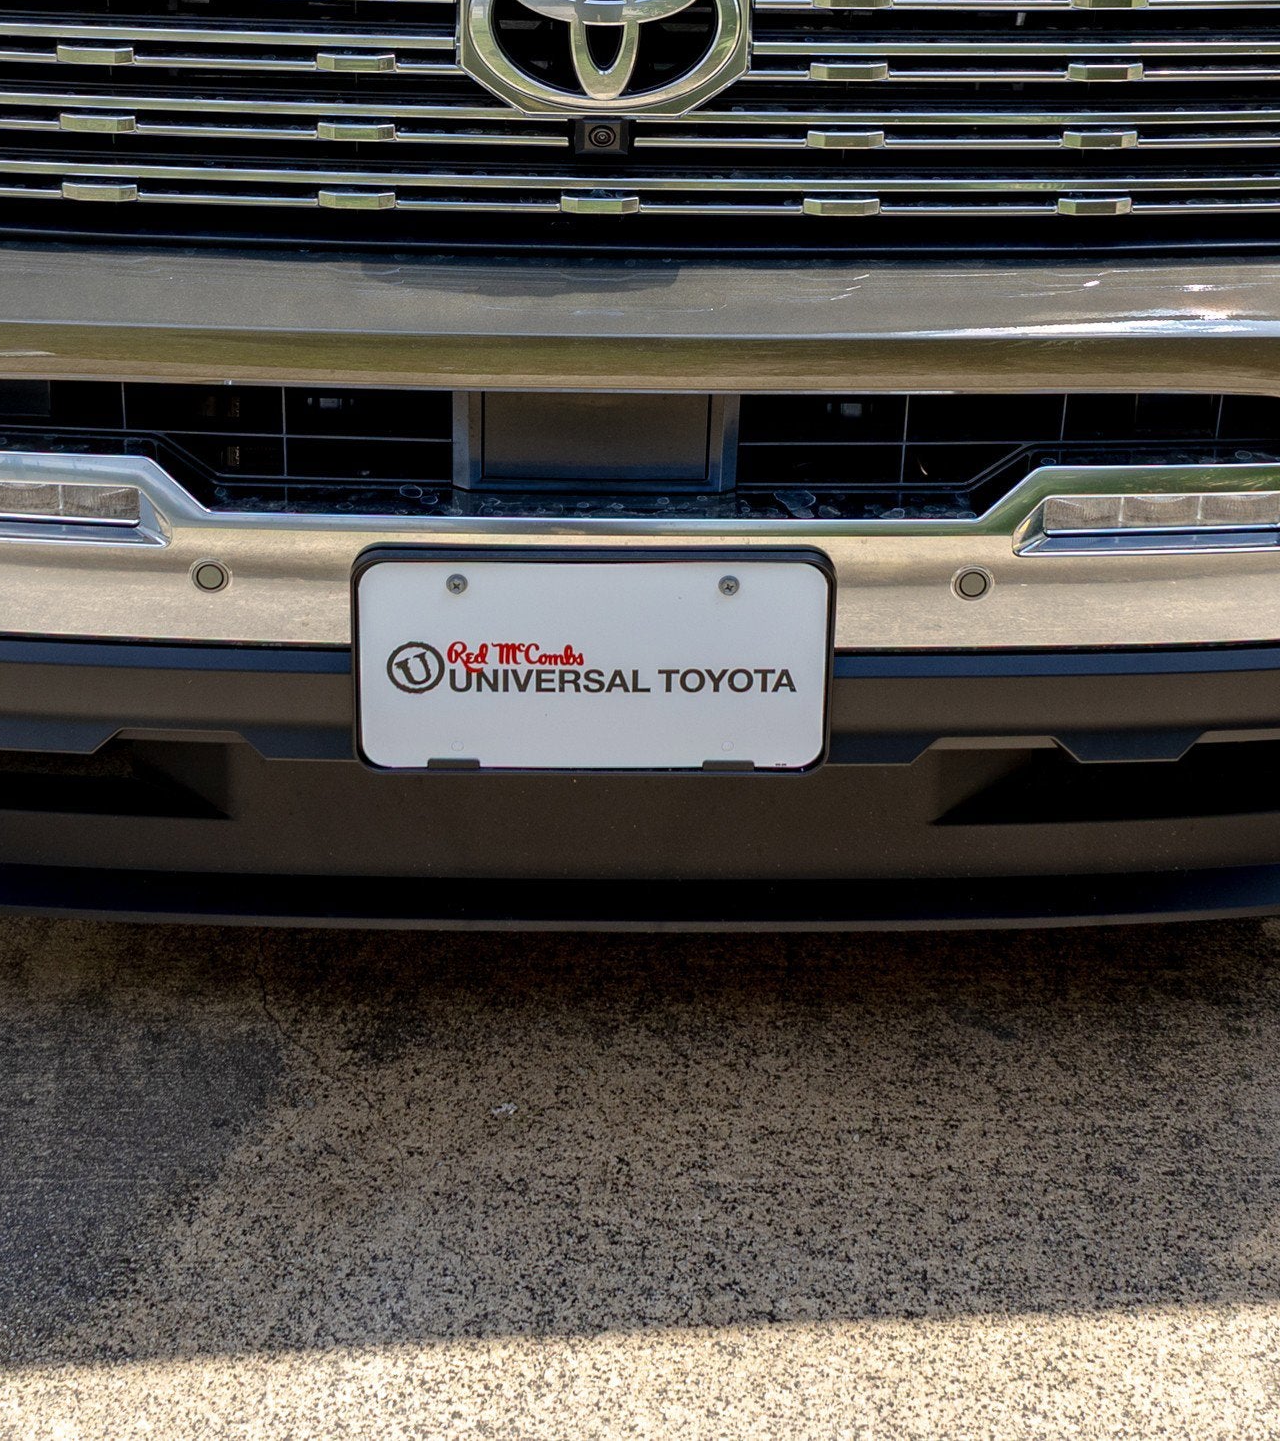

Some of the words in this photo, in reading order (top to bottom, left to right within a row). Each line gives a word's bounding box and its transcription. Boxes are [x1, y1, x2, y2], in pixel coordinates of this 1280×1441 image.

[447, 641, 488, 673] Red
[492, 642, 584, 666] McCombs
[449, 668, 651, 693] UNIVERSAL
[658, 668, 797, 693] TOYOTA
